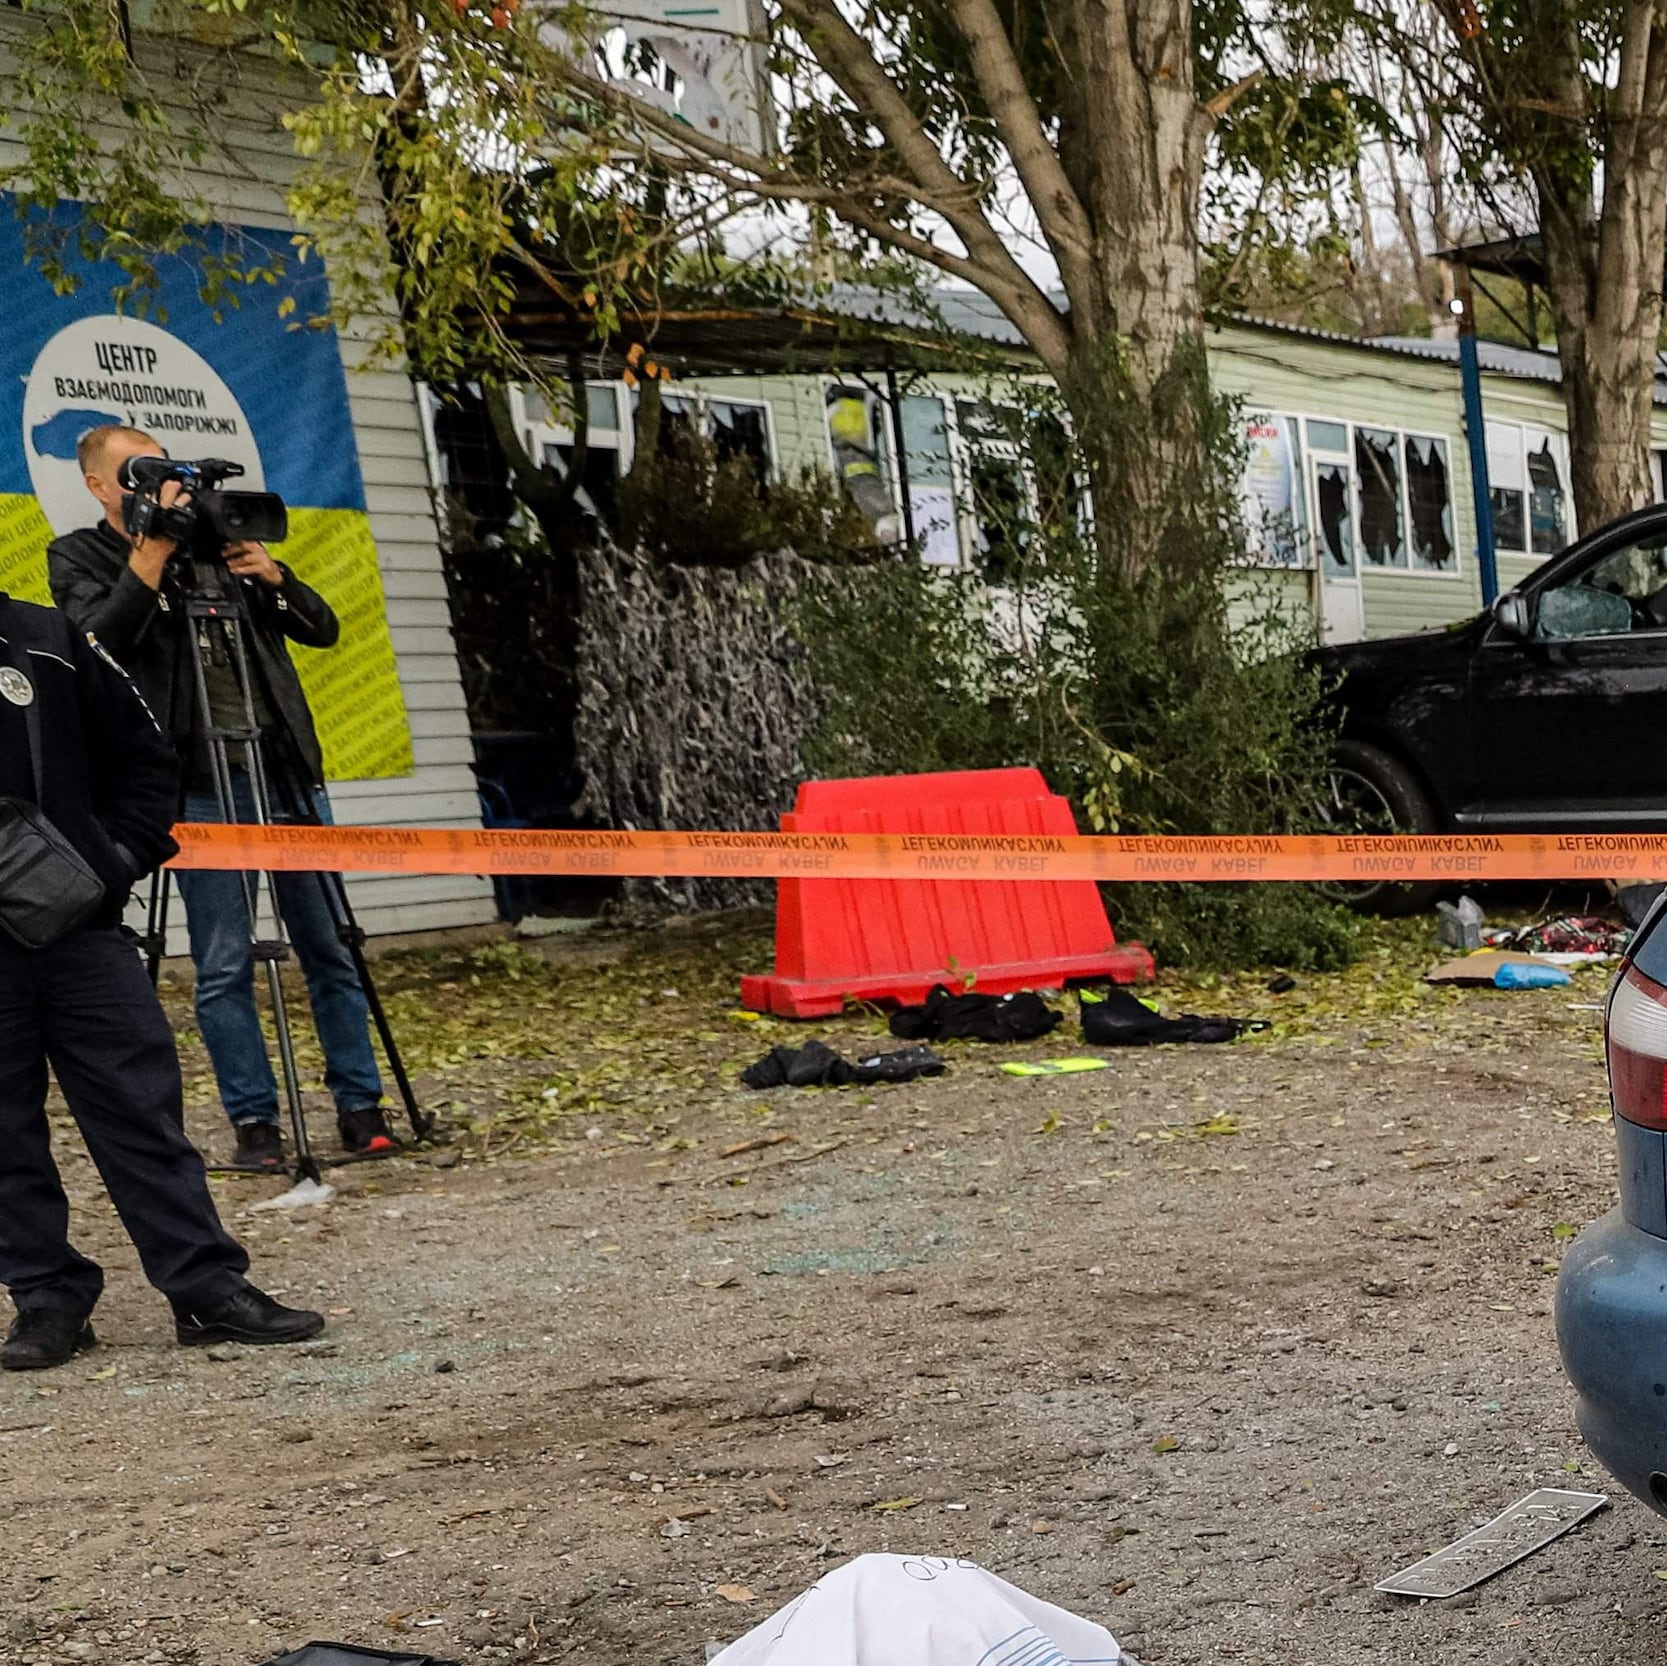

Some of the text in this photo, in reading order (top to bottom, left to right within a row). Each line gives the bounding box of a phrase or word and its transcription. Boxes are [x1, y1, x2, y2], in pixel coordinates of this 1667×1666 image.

[95, 341, 157, 376] ЦЕНТР
[54, 377, 207, 410] ВЗАЄМОДОПОМОГИ
[143, 411, 239, 435] ЗАПОРІЖЖІ
